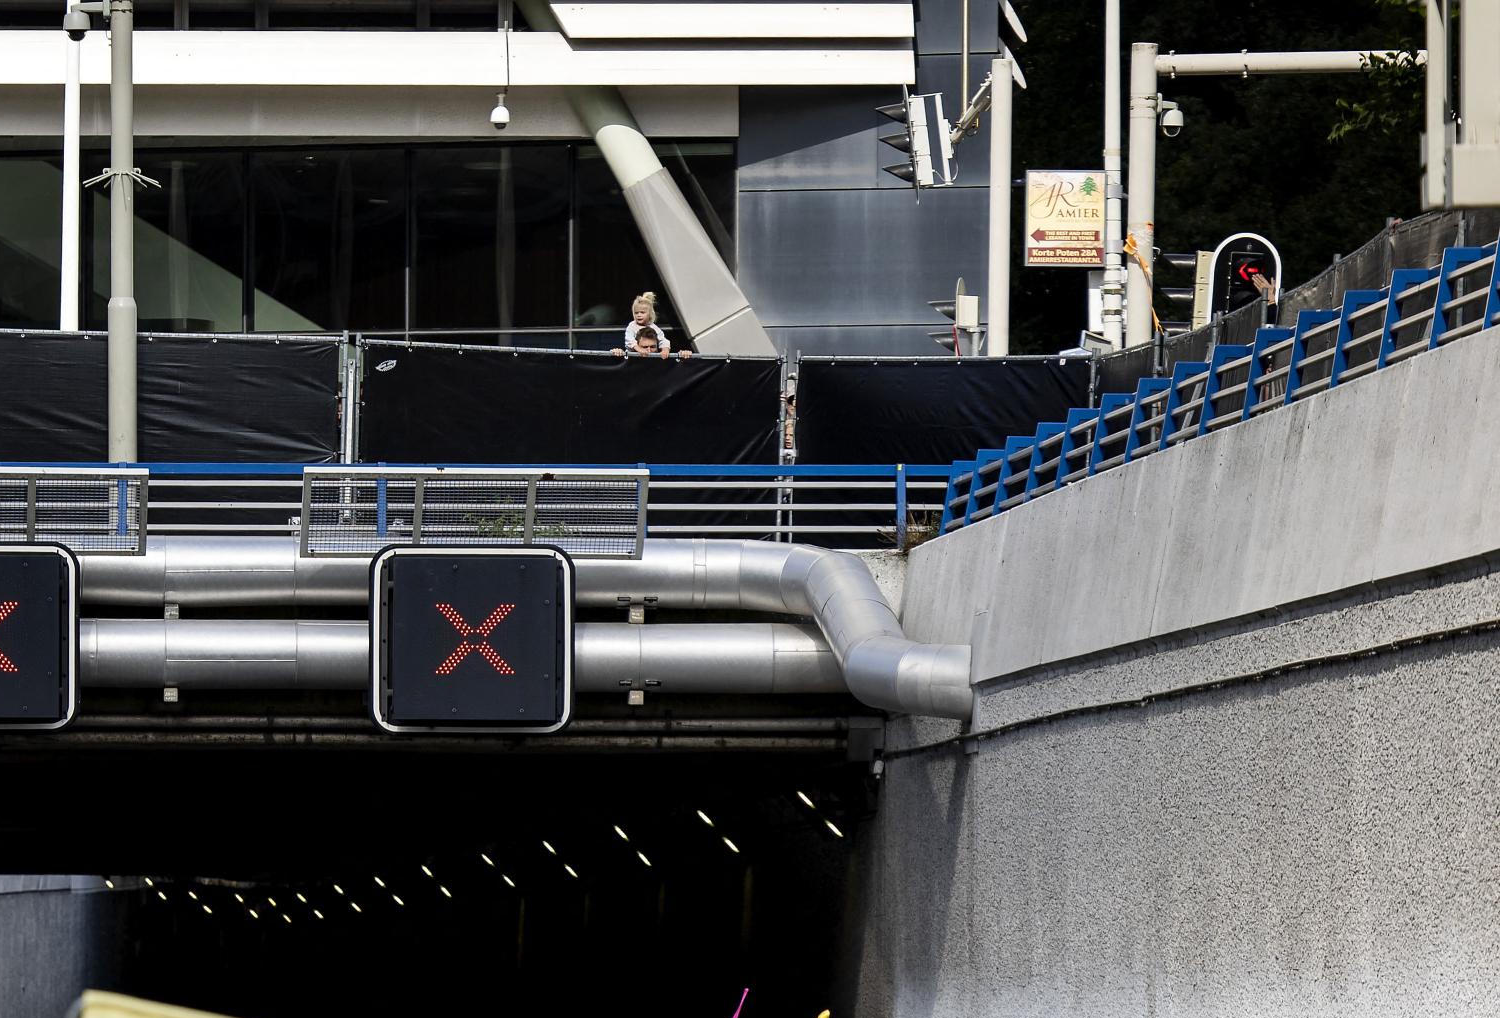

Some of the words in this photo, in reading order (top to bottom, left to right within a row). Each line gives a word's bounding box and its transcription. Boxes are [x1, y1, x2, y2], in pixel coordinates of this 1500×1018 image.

[1057, 208, 1100, 218] AMIER
[1032, 249, 1054, 257] Korte
[1056, 249, 1079, 257] Poten
[1081, 249, 1098, 257] 28A
